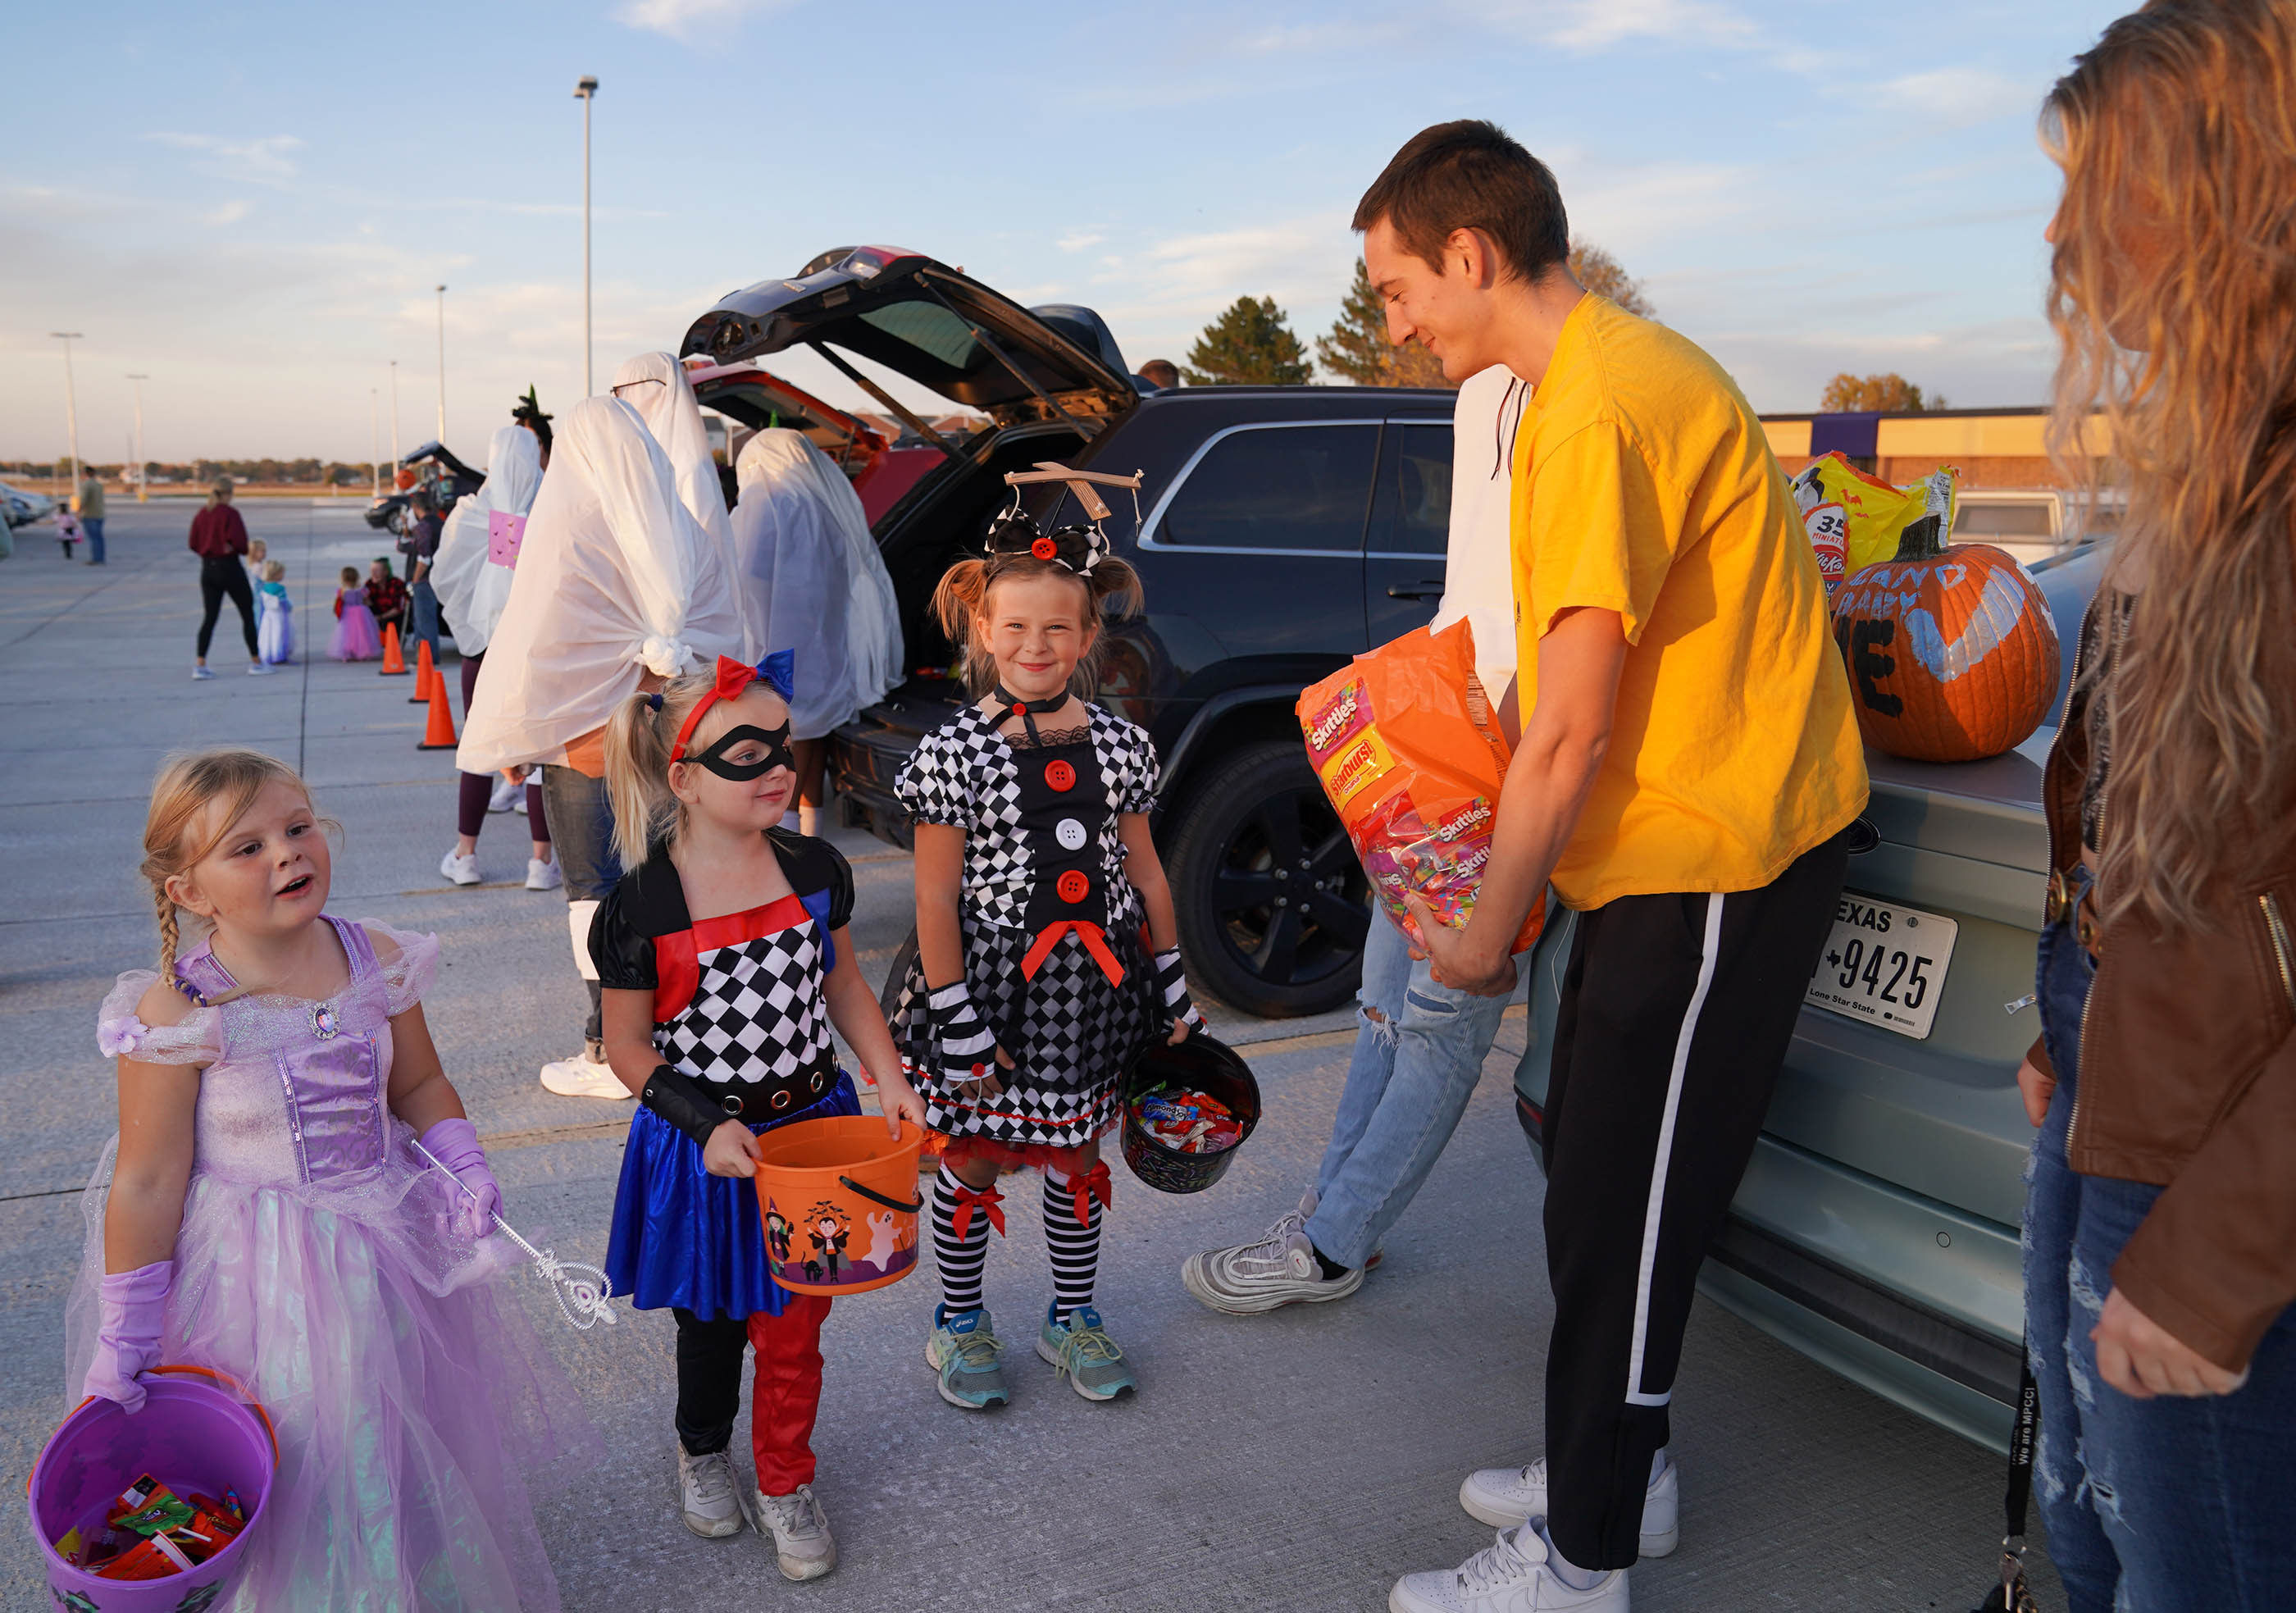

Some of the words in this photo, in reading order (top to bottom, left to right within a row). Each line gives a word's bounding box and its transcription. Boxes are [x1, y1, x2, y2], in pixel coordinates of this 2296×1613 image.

[1312, 698, 1358, 751] Skittles
[1331, 740, 1374, 796] Starburst
[1439, 806, 1492, 843] Skittles
[1839, 938, 1934, 1009] 9425
[1810, 987, 1830, 1000] Lone
[1832, 995, 1851, 1007] Star
[1852, 1001, 1876, 1015] State
[1145, 1104, 1177, 1114] Almond
[2021, 1427, 2031, 1445] are
[2019, 1447, 2029, 1465] We
